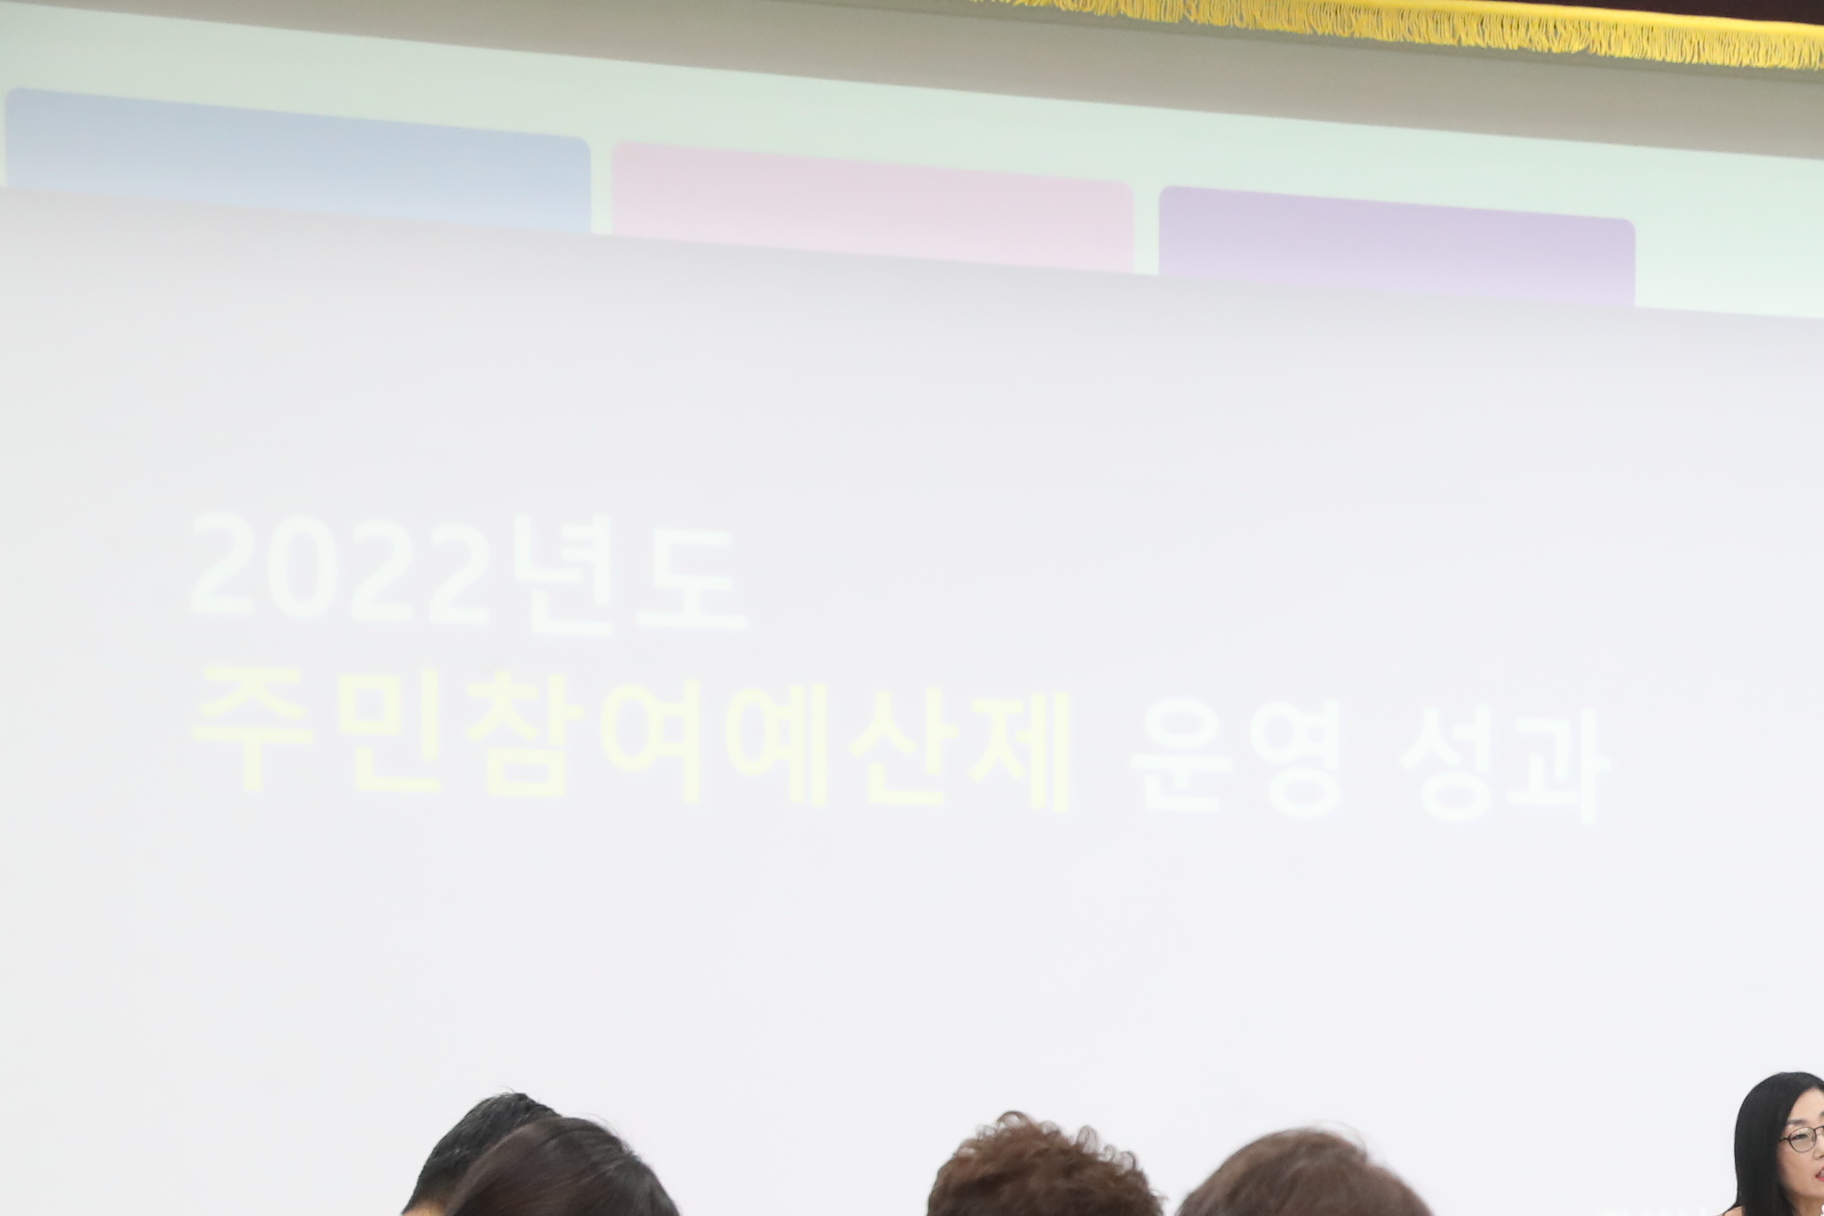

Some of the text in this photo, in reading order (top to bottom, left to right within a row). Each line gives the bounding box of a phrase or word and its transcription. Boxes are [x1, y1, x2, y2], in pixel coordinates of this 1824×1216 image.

[188, 510, 749, 638] 2022년도
[190, 663, 1611, 826] 주민참여예산제 운영 성과
